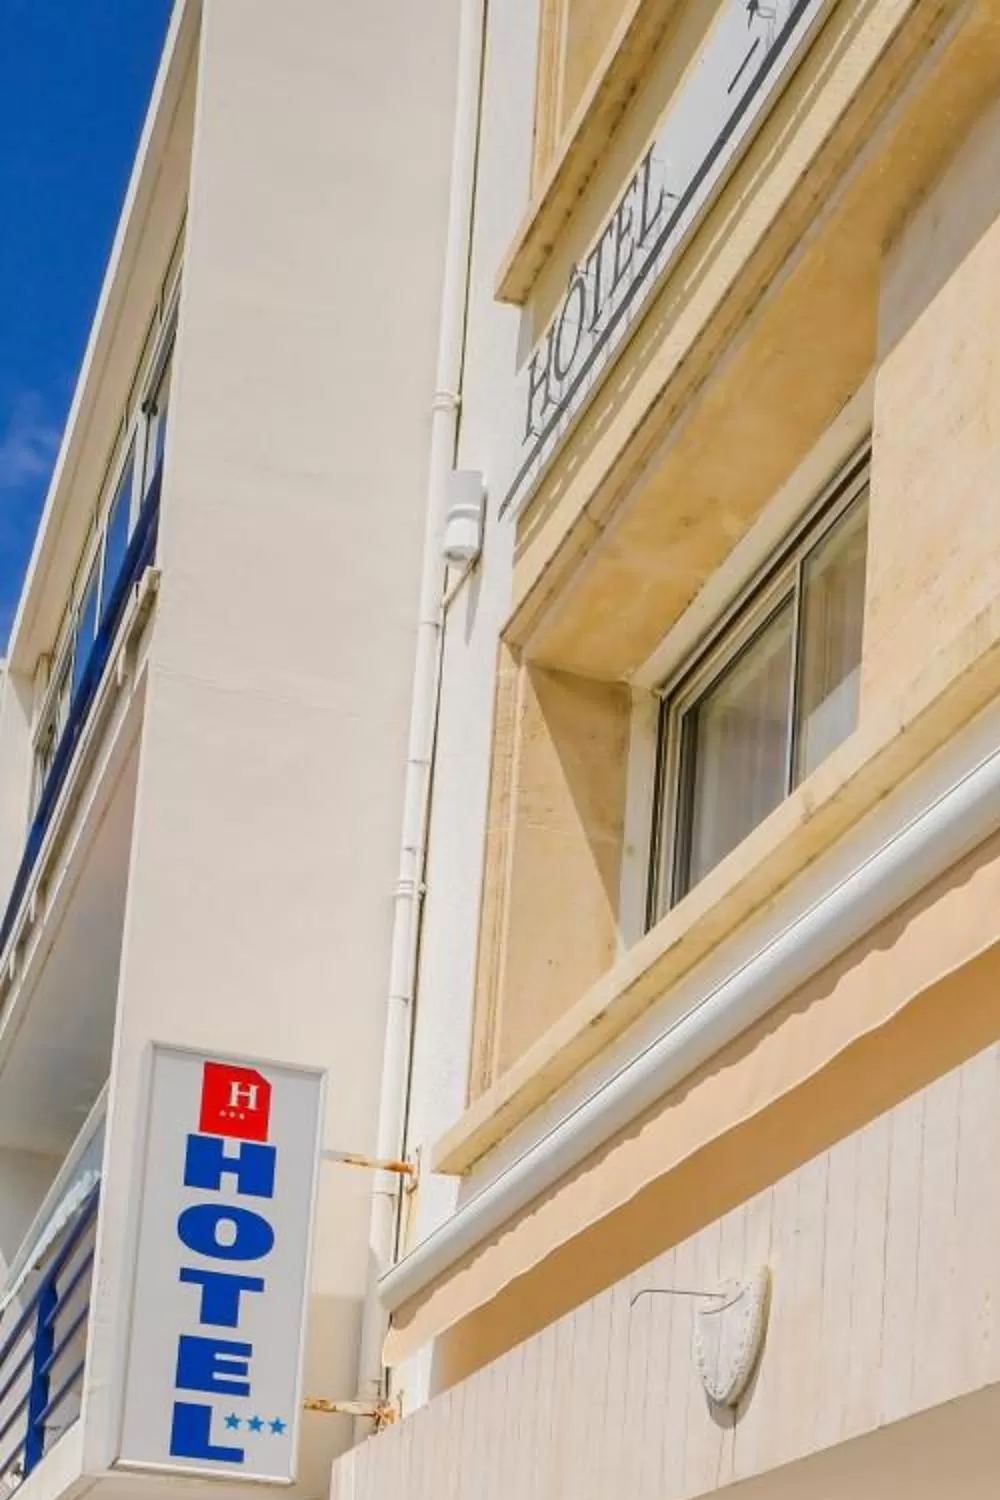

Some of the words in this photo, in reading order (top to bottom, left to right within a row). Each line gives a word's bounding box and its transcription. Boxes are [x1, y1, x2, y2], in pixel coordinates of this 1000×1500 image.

[522, 141, 667, 446] HOTEL
[227, 1081, 260, 1111] H
[169, 1133, 277, 1463] HOTEL
